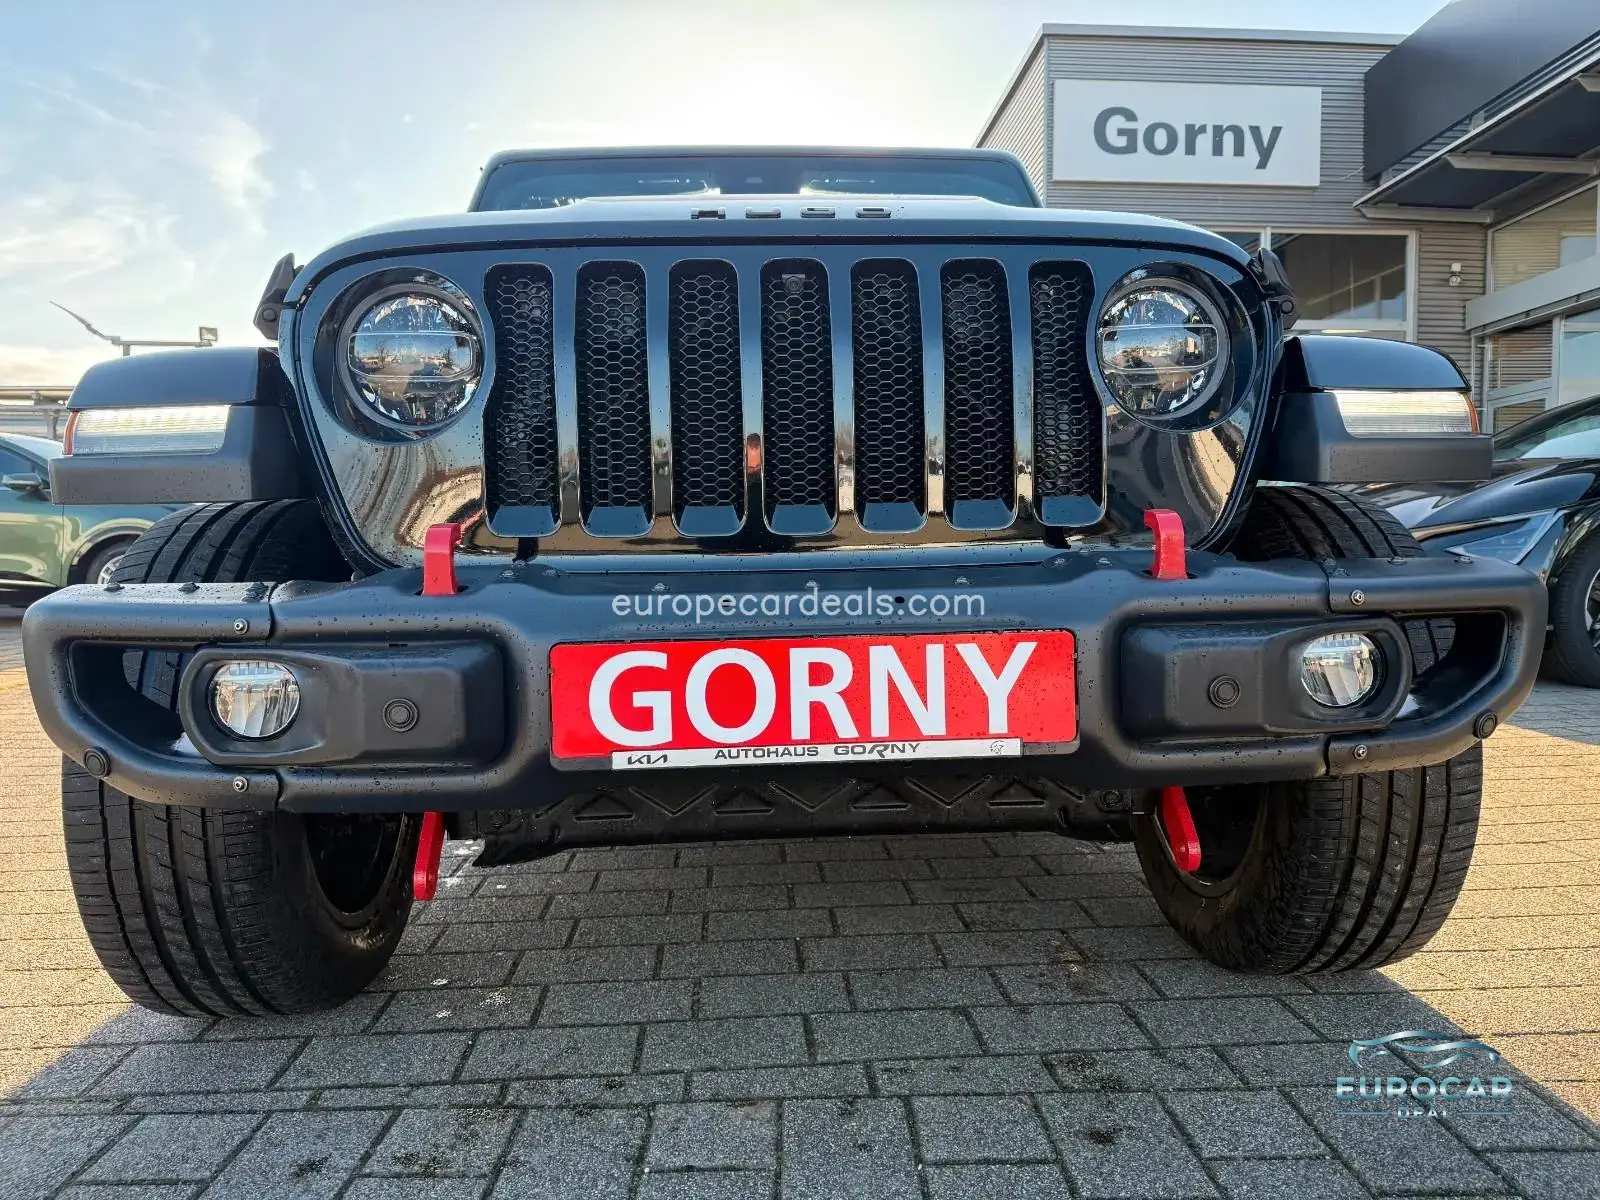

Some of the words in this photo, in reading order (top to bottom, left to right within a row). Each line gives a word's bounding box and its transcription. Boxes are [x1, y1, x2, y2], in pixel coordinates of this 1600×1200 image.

[1093, 106, 1284, 170] Gorny
[588, 641, 1038, 747] GORNY
[713, 746, 819, 760] AUTOHAUS
[833, 742, 921, 759] GORNY
